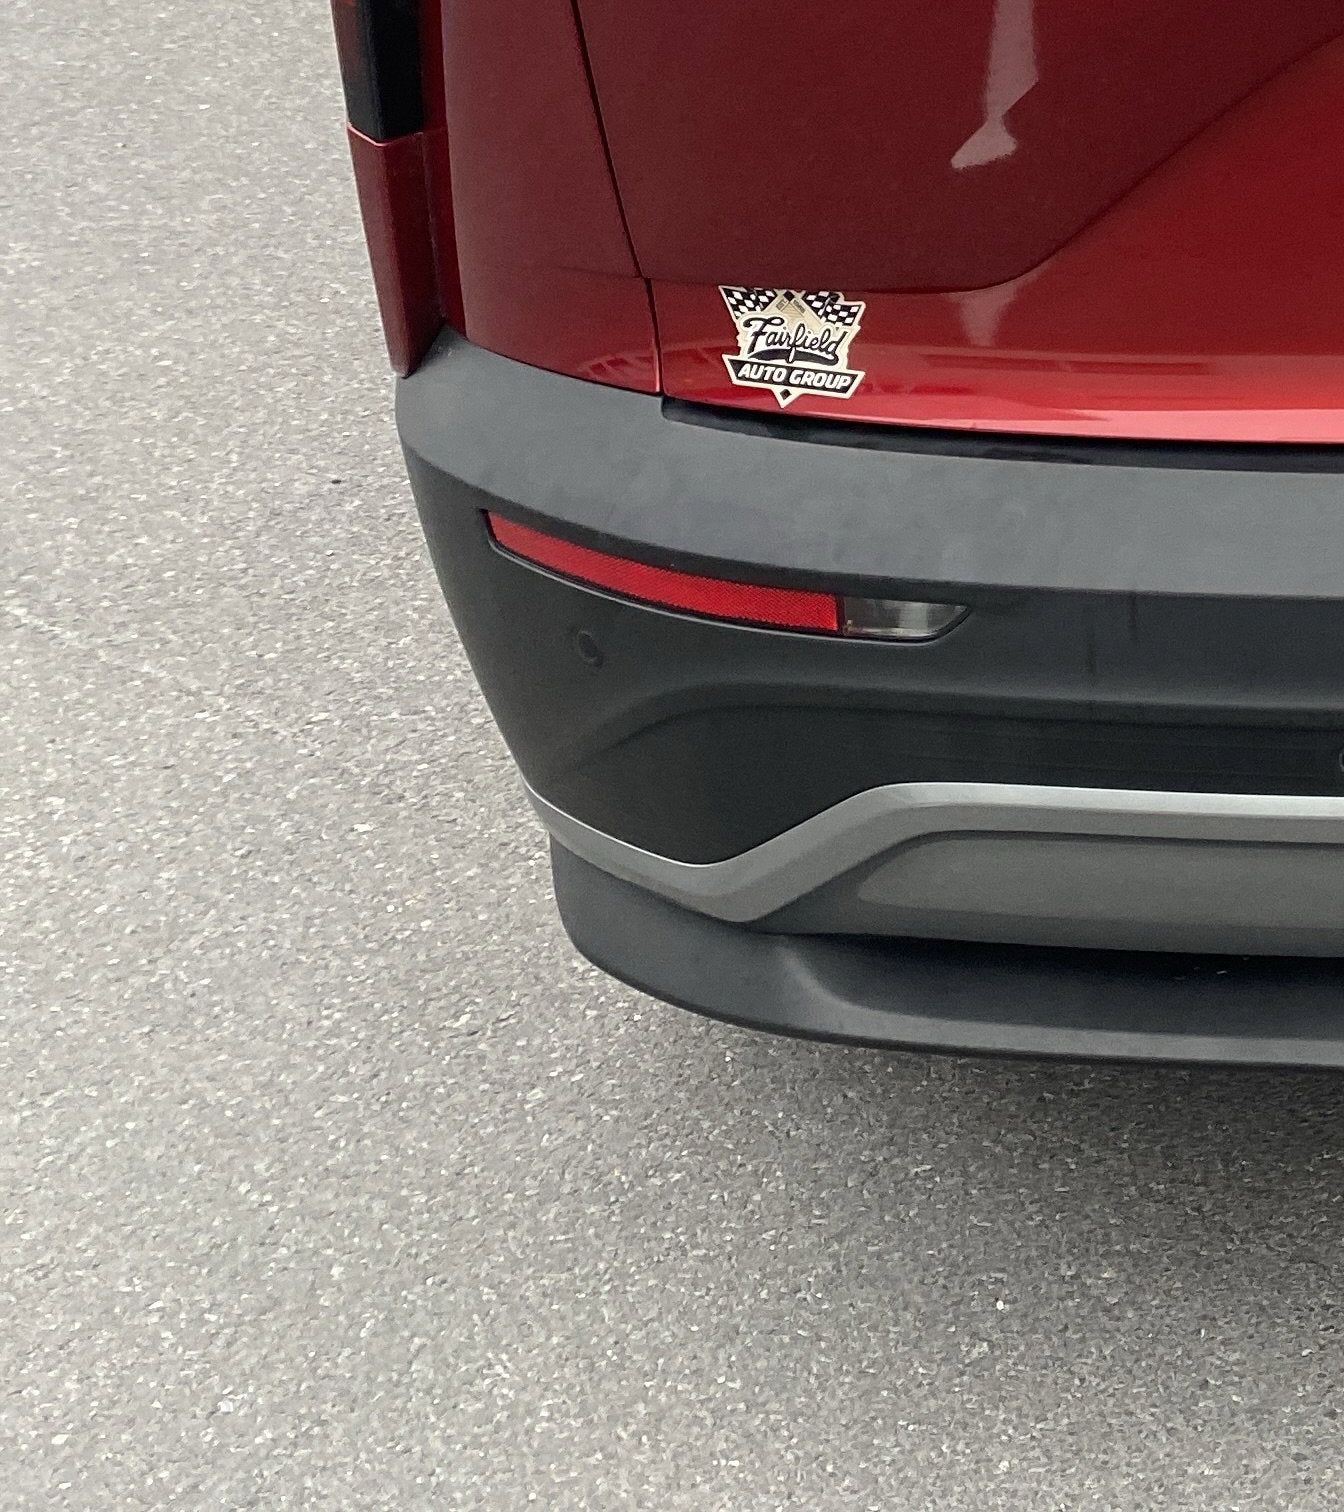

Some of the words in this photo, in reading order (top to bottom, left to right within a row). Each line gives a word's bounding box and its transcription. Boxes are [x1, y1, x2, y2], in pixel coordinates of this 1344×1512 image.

[742, 316, 848, 360] Fairfield
[737, 363, 787, 384] AUTO
[789, 370, 853, 390] GROUP
